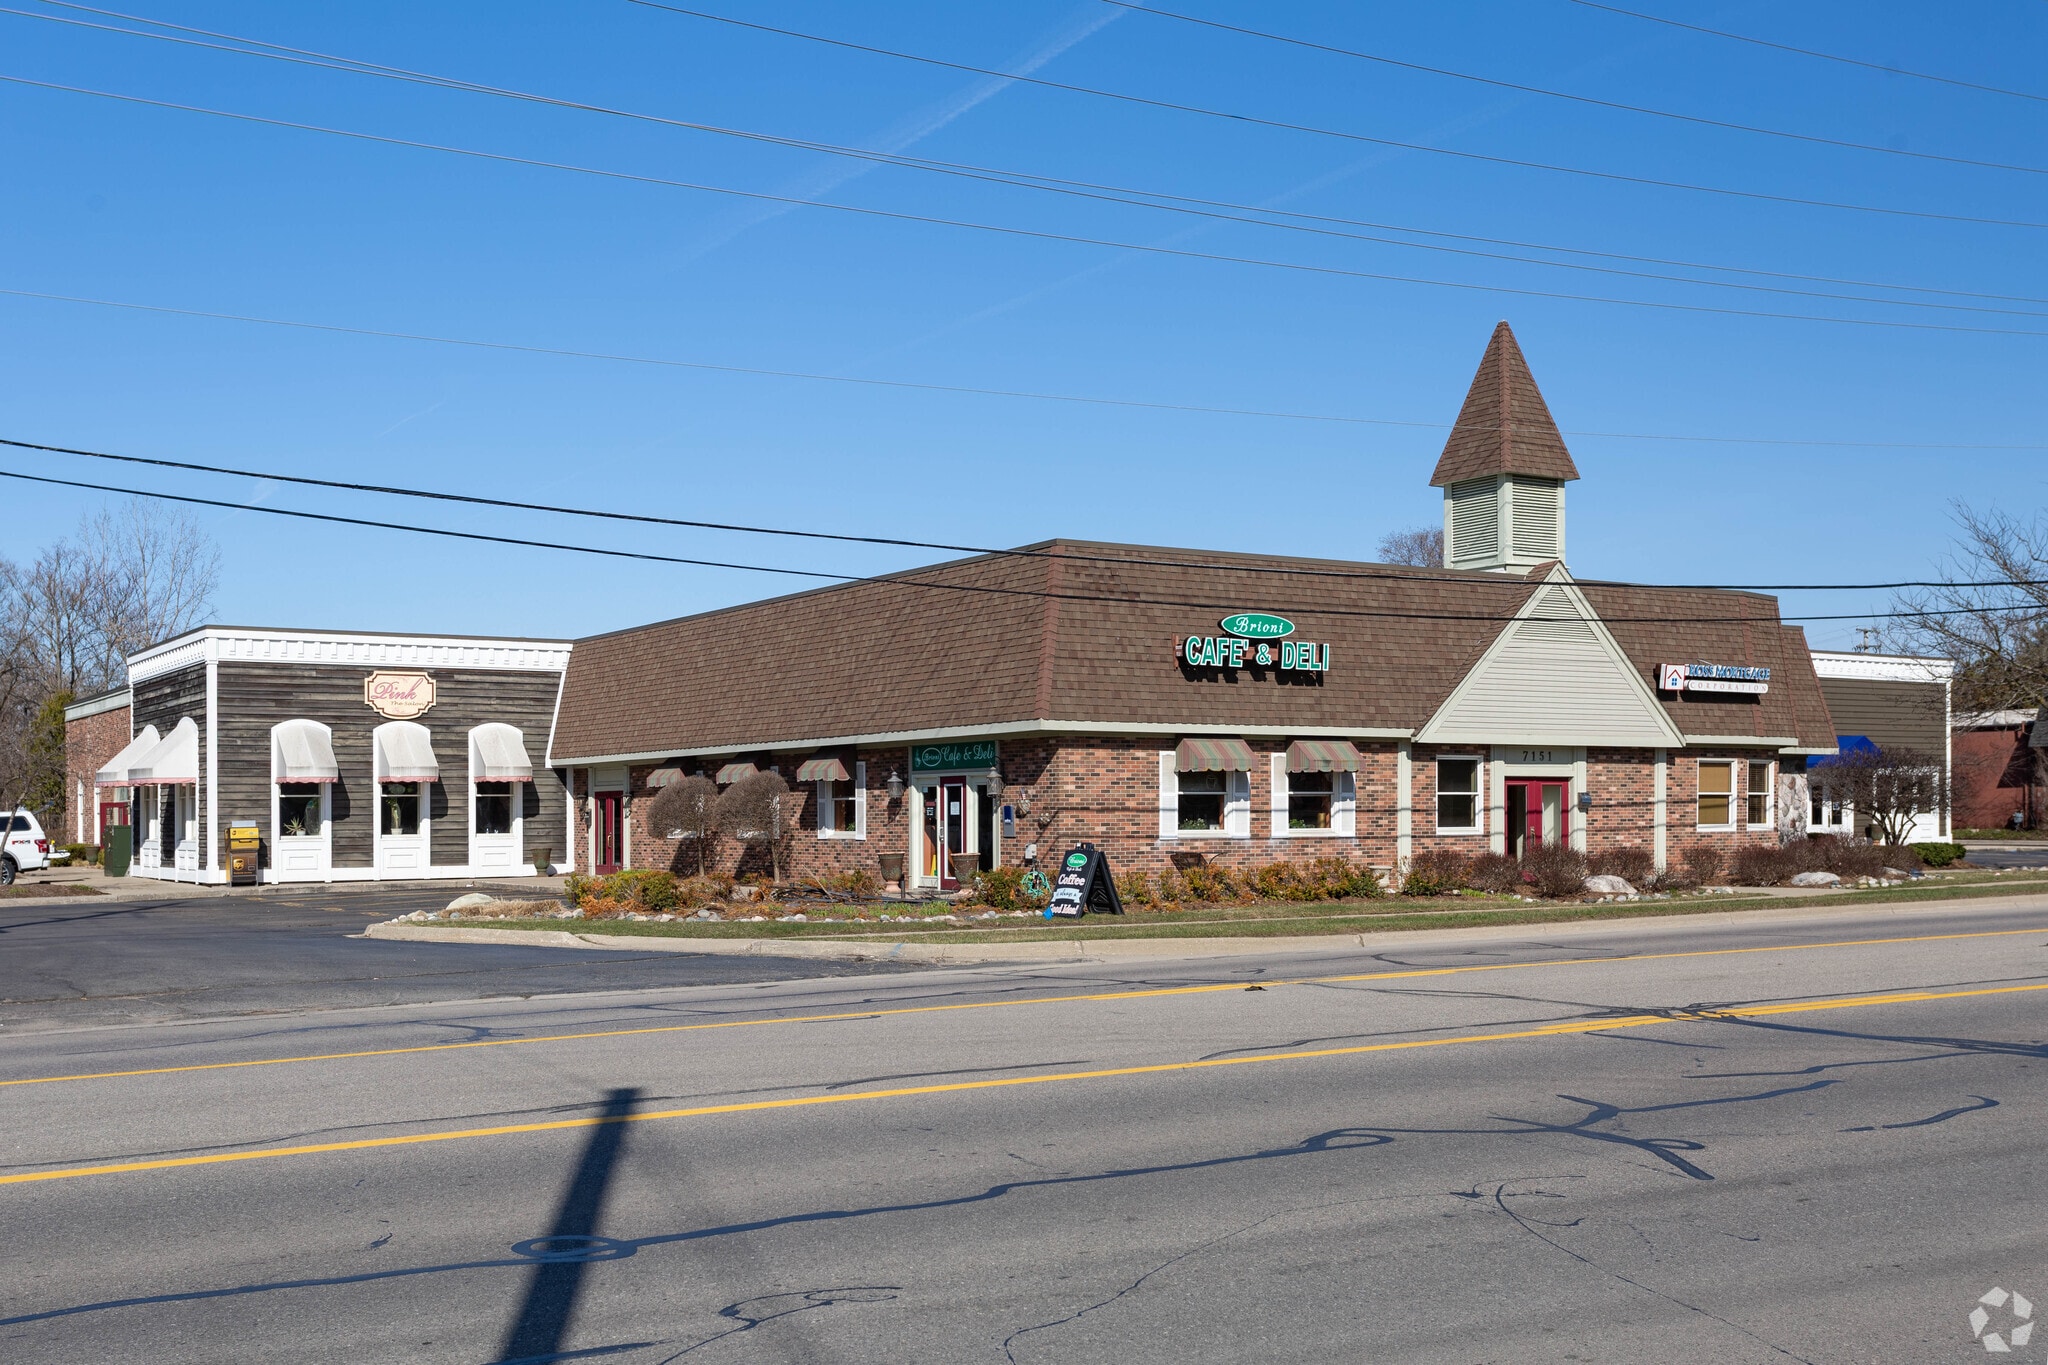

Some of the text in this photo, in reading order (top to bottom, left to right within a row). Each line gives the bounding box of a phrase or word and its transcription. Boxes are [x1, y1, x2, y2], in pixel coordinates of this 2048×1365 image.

[1234, 617, 1283, 634] Brioni
[1256, 643, 1272, 665] &
[1281, 641, 1330, 671] DELI
[1689, 664, 1770, 680] ROSS MORTGAGE
[370, 678, 423, 700] Pink
[1690, 682, 1767, 692] CORPORATION
[941, 746, 961, 766] Cafe
[963, 746, 972, 760] &
[973, 744, 994, 760] Deli
[1523, 750, 1552, 761] 7151
[1058, 874, 1085, 885] Coffee
